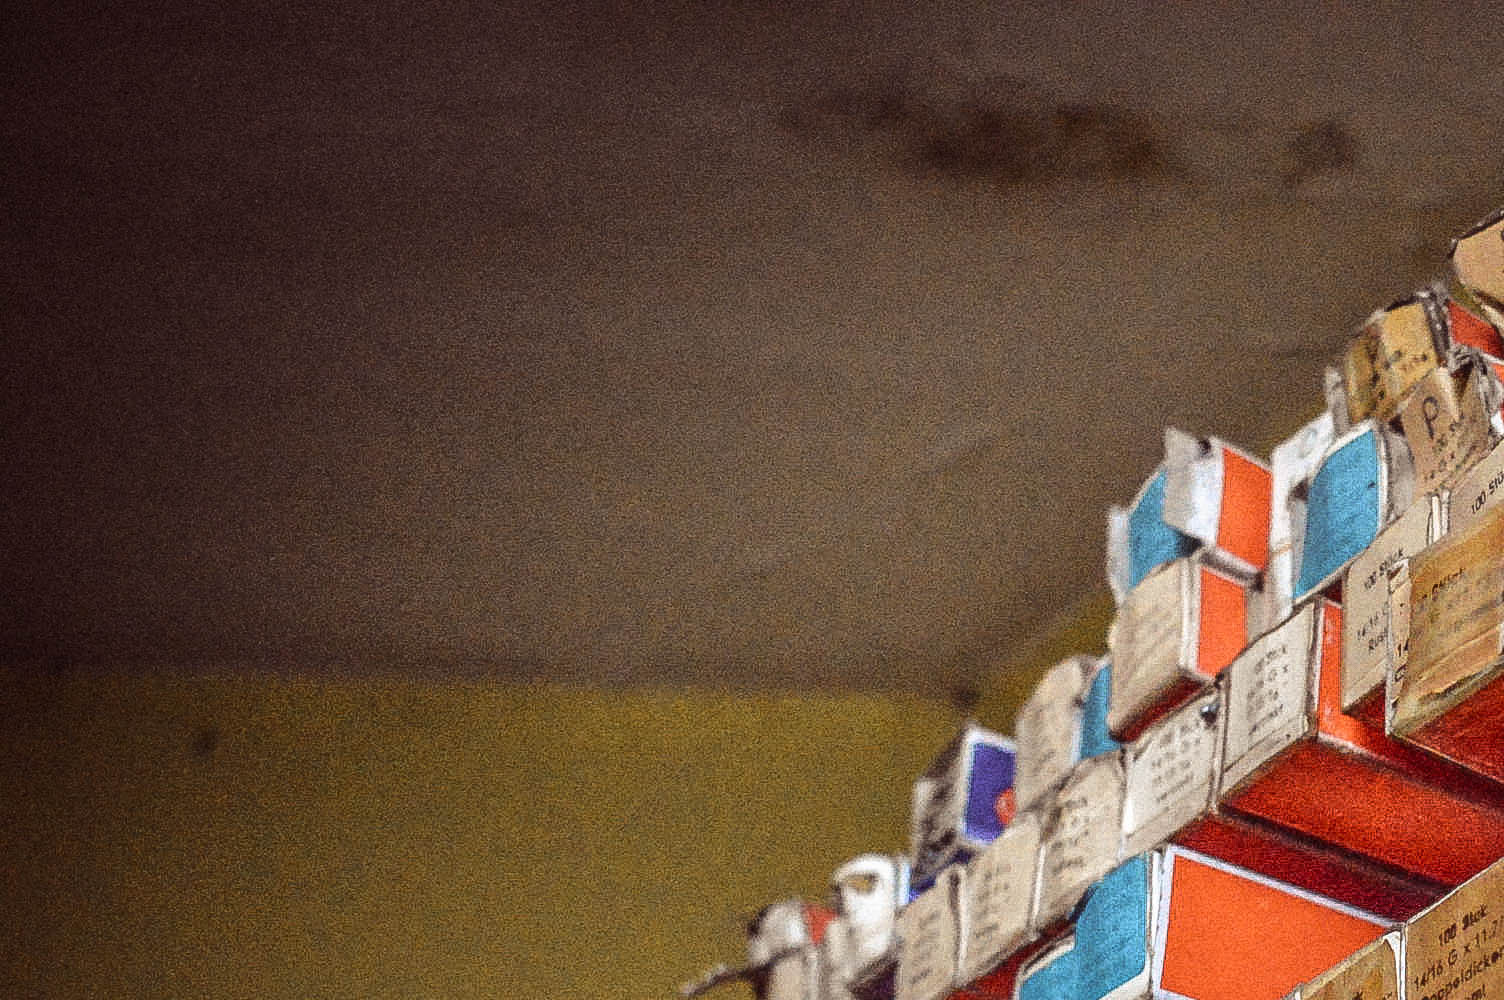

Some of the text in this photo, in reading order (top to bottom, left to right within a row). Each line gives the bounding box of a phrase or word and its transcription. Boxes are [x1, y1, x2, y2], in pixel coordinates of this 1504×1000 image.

[1438, 922, 1457, 947] 100
[1447, 948, 1458, 968] G
[1463, 942, 1472, 957] x
